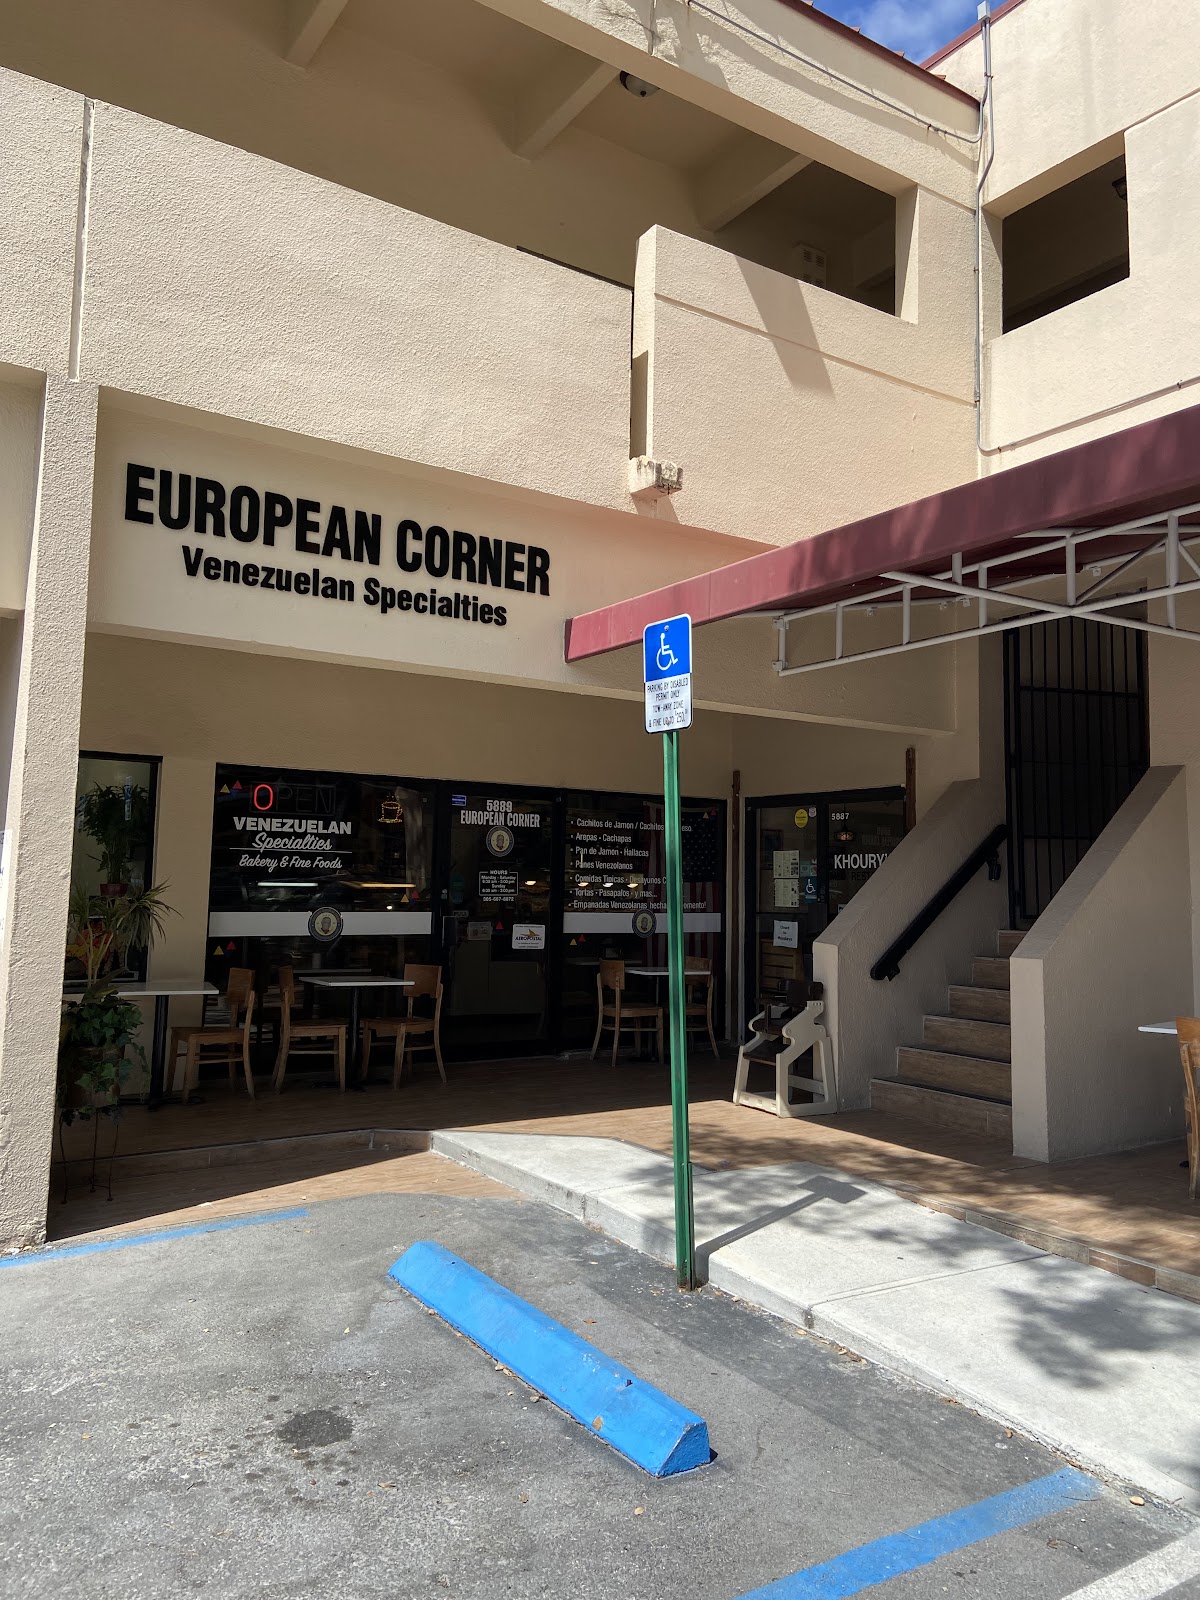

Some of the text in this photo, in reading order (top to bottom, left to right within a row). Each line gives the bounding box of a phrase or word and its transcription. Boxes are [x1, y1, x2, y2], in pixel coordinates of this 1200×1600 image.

[124, 463, 550, 596] EUROPEAN CORNER
[182, 546, 508, 626] Venezuelan Specialties
[648, 678, 688, 693] PARKING BY DISABLED
[656, 690, 680, 701] PERMIT ONLY
[653, 700, 684, 713] TOW-AWAY ZONE
[653, 718, 661, 727] FINE
[487, 800, 512, 812] 5889
[461, 810, 540, 827] EUROPEAN CORNER
[576, 818, 603, 828] Cachitos
[604, 819, 612, 828] de
[614, 820, 634, 829] Jamon
[640, 822, 664, 831] Cachitos
[233, 817, 351, 835] VENEZUELAN
[252, 832, 332, 853] Specialties
[575, 833, 632, 844] Arepas Cachapas
[575, 846, 649, 857] Pan de Jamon Hallacas
[239, 855, 342, 872] Bakery & Fine Foods
[575, 860, 633, 870] Panes Venezolanos
[834, 853, 888, 869] KHOURY'
[575, 874, 601, 883] Comidas
[630, 875, 661, 885] Desayunos
[851, 872, 871, 880] REST
[575, 888, 594, 896] Tortas
[599, 889, 629, 898] Pasapalos
[574, 900, 609, 909] Empanadas
[650, 901, 667, 909] hecha
